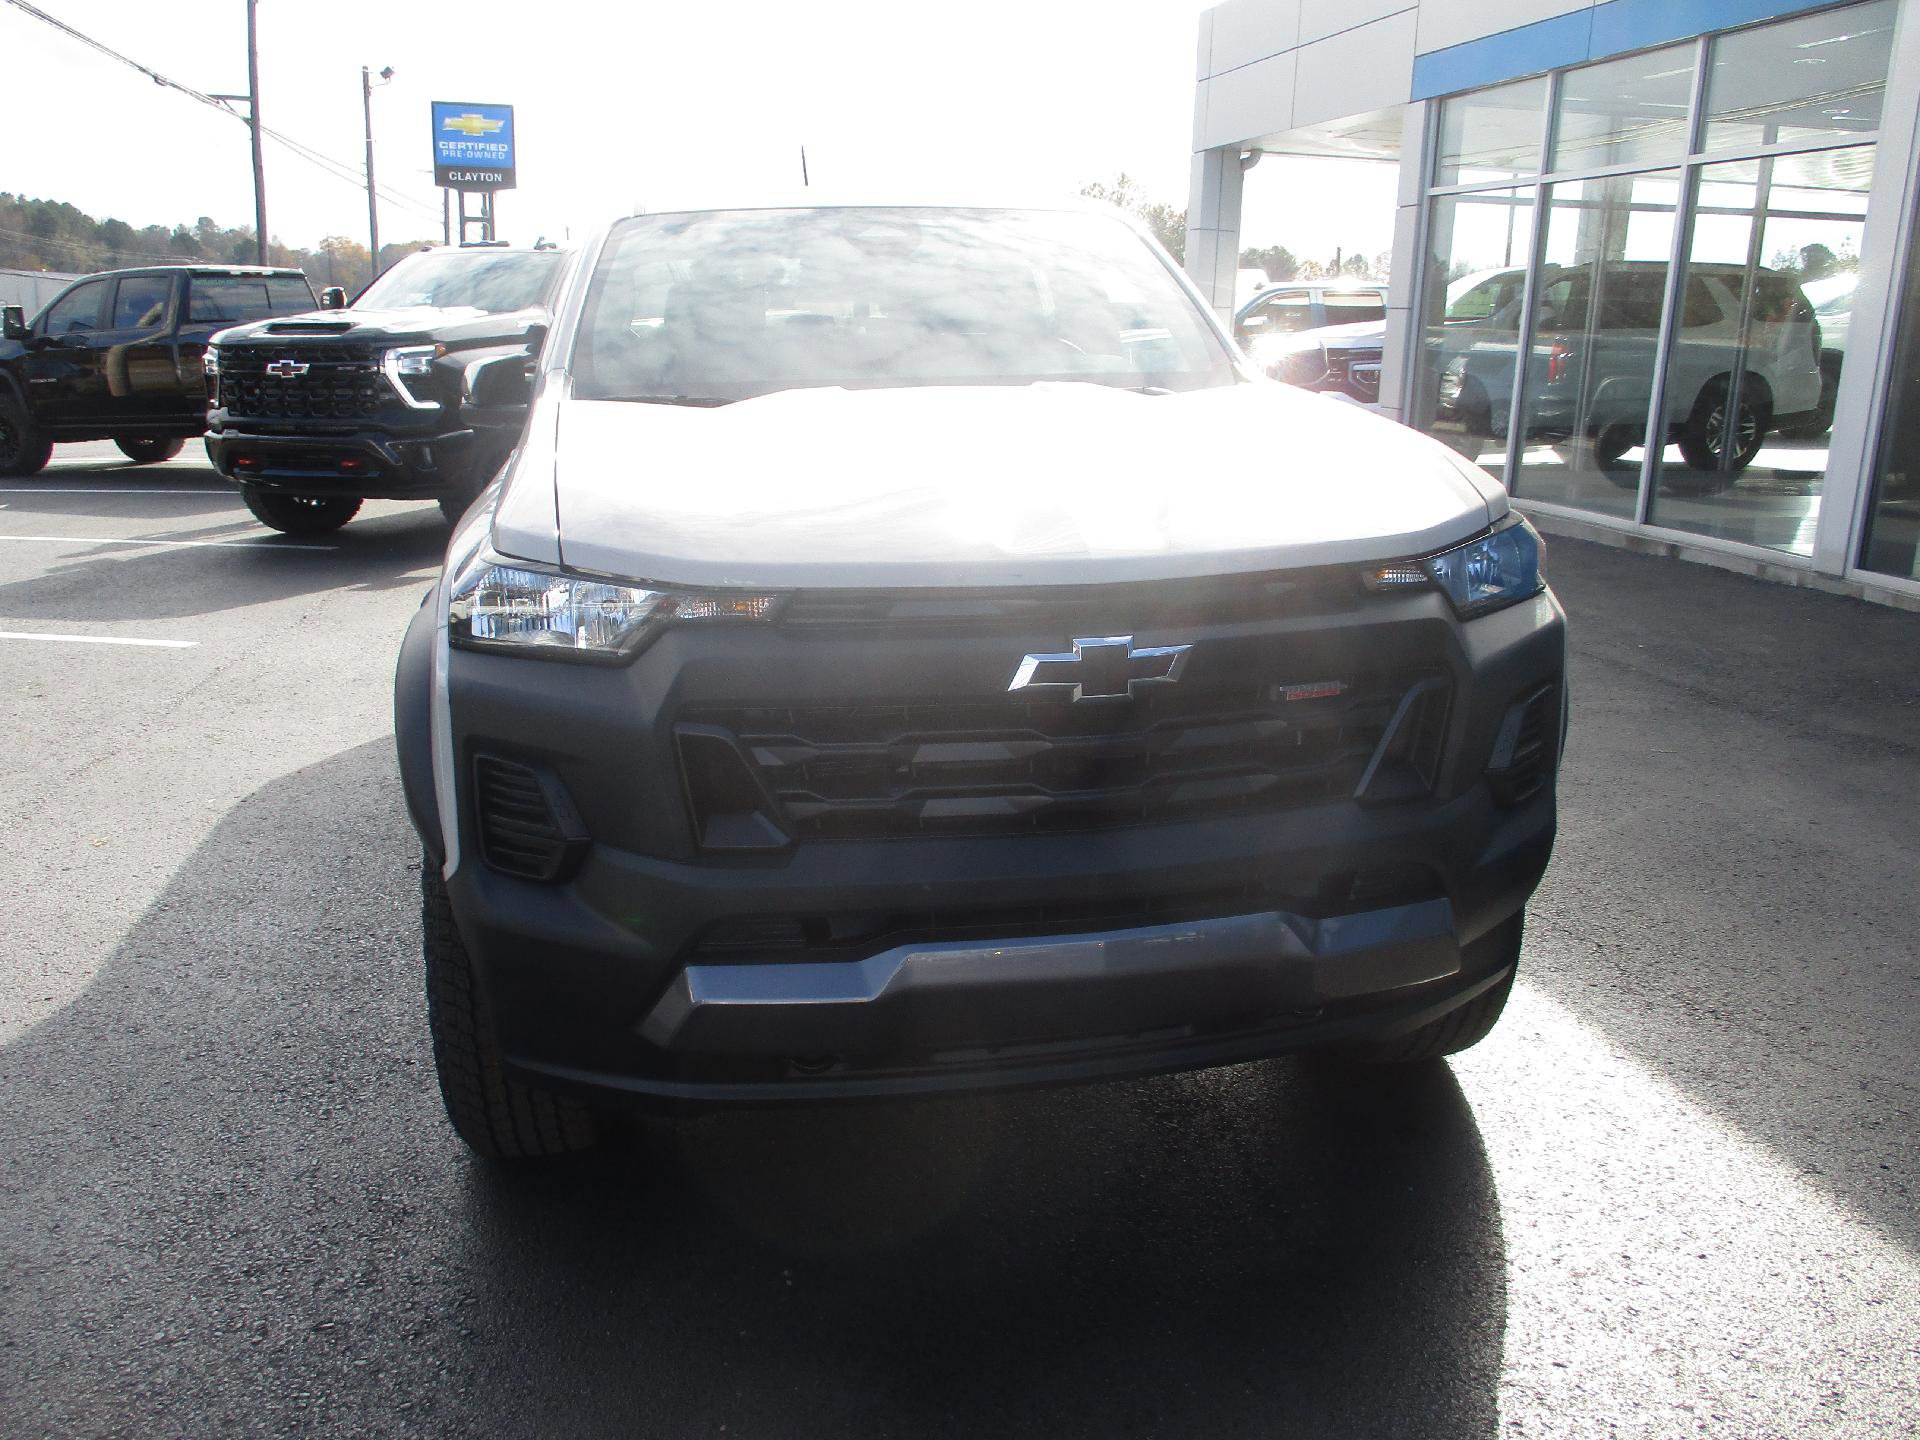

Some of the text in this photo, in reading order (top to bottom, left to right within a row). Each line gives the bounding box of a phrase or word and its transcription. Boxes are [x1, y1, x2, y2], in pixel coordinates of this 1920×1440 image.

[439, 141, 508, 152] CERTIFIED
[442, 149, 505, 159] PRE-OWNED
[448, 171, 502, 182] CLAYTON
